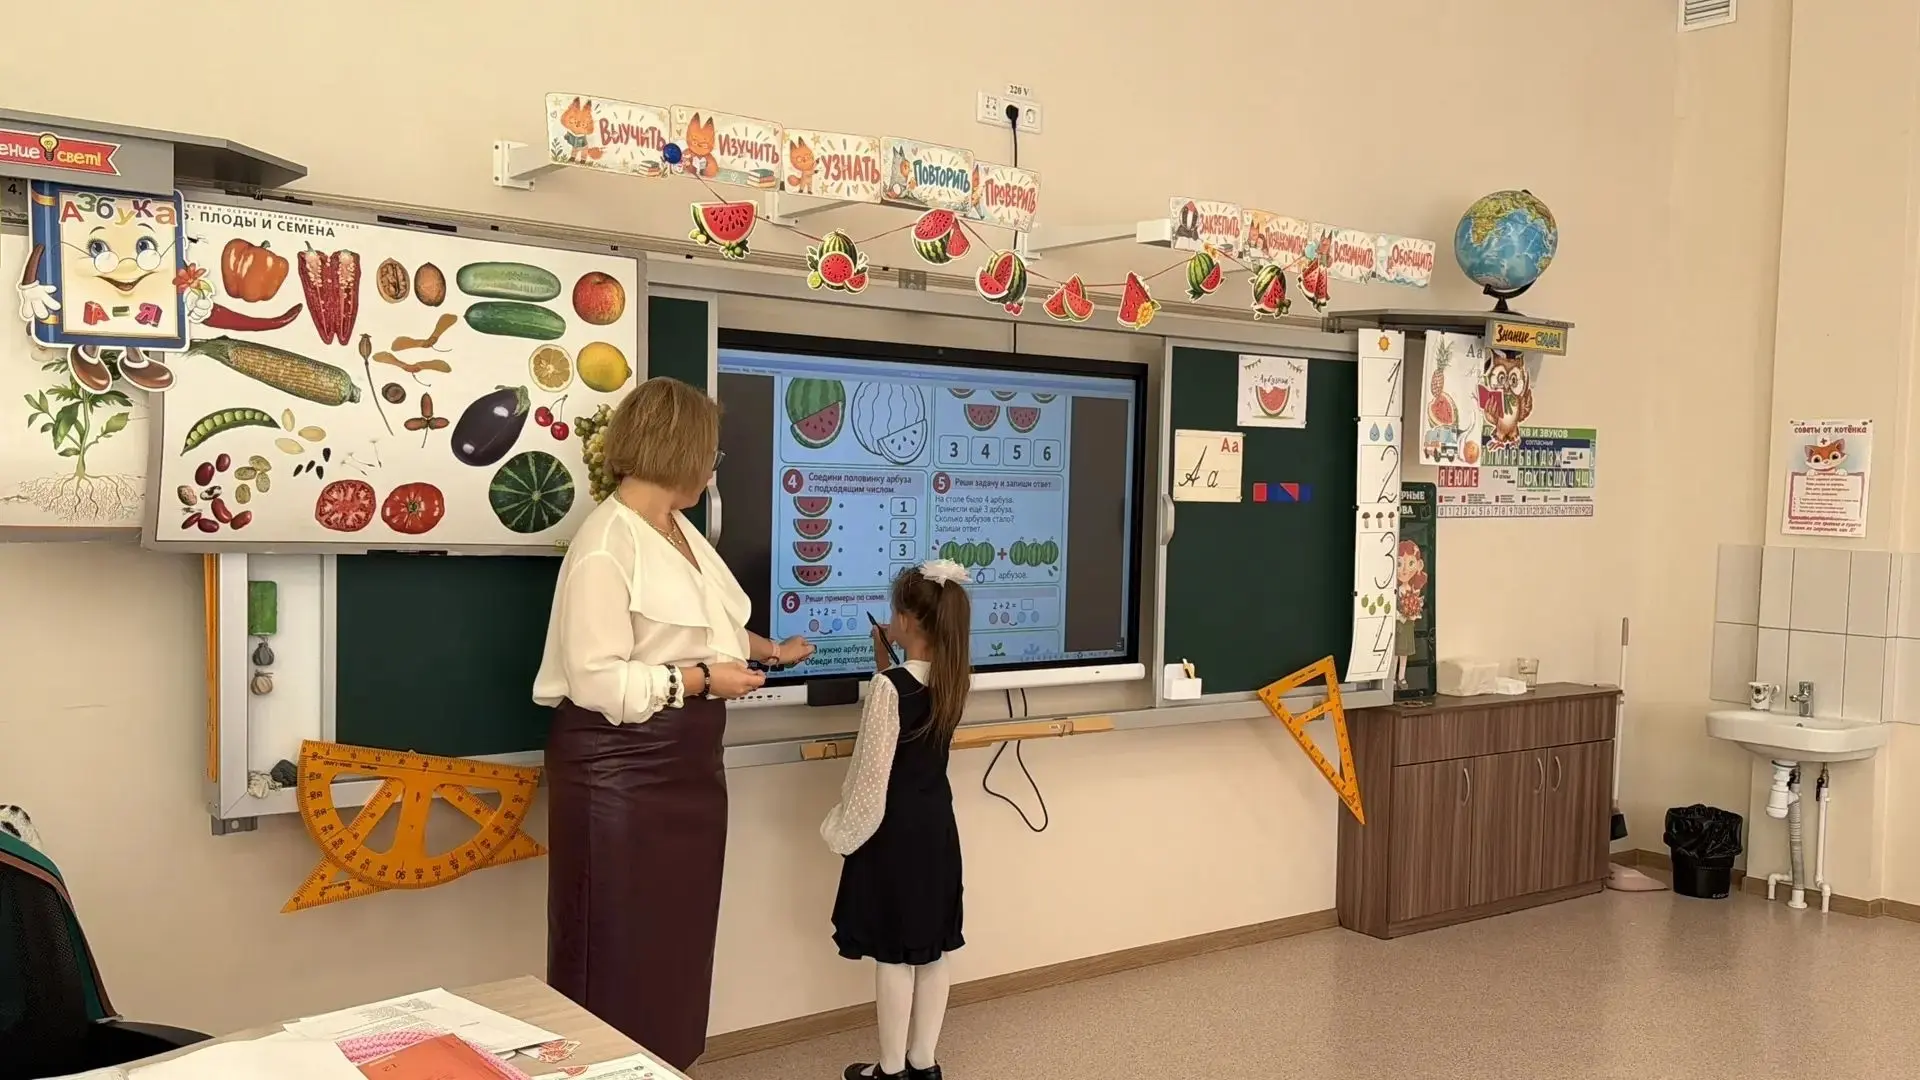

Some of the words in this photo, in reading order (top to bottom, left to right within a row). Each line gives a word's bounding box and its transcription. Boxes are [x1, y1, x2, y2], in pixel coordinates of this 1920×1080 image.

[1009, 85, 1022, 96] 220
[1022, 86, 1030, 96] V
[821, 154, 881, 184] УЗНАТЬ
[200, 211, 256, 228] ПЛОДЫ
[262, 219, 272, 230] И
[277, 221, 336, 238] СЕМЕНА
[949, 441, 959, 458] 3
[981, 443, 991, 459] 4
[1013, 444, 1021, 460] 5
[1043, 446, 1051, 461] 6
[787, 476, 798, 489] 4
[808, 472, 842, 483] Соедини
[844, 474, 884, 485] половинку
[886, 474, 912, 486] арбуза
[938, 476, 946, 490] 5
[955, 477, 974, 487] Реши
[975, 479, 999, 489] задачу
[1006, 480, 1032, 488] запиши
[814, 485, 865, 494] подходящим
[965, 495, 983, 504] было
[900, 501, 908, 513] 1
[935, 505, 967, 514] Принесли
[983, 505, 988, 513] 3
[935, 515, 964, 523] Сколько
[965, 515, 991, 525] арбузов
[899, 522, 907, 534] 2
[935, 525, 961, 533] Запиши
[899, 544, 907, 556] 3
[785, 595, 795, 609] 6
[805, 594, 824, 603] Реши
[825, 595, 855, 603] примеры
[992, 602, 998, 610] 2
[1005, 602, 1010, 610] 2
[809, 607, 814, 616] 1
[824, 607, 829, 616] 2
[819, 647, 842, 655] нужно
[843, 644, 867, 654] арбузу
[805, 657, 832, 667] Обведи
